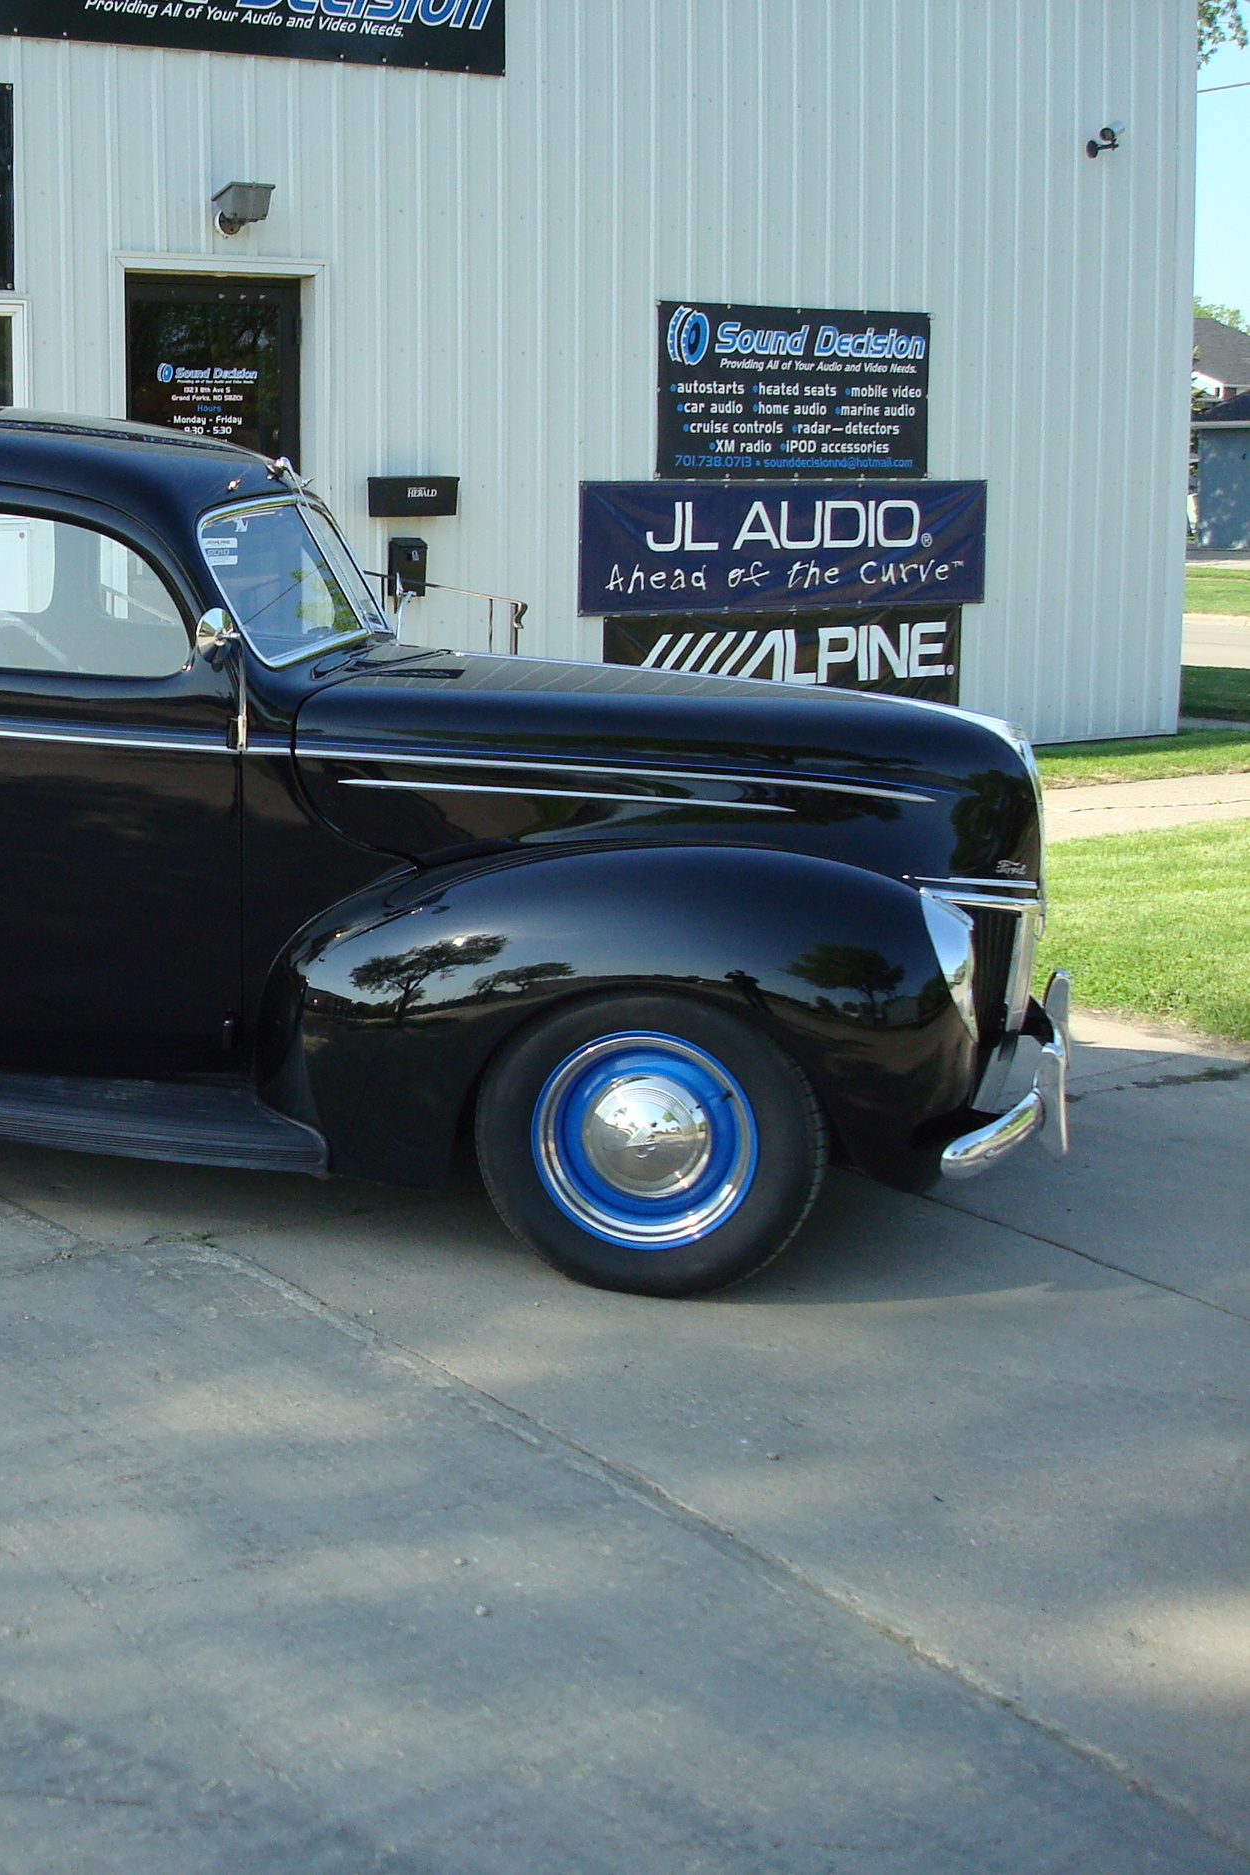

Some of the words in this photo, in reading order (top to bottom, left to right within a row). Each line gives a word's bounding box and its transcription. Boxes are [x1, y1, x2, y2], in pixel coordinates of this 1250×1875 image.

[85, 0, 158, 17] Providing
[160, 3, 183, 17] All
[185, 5, 204, 19] of
[205, 6, 238, 22] Your
[240, 12, 283, 27] Audio
[285, 15, 313, 28] and
[317, 18, 356, 33] Video
[359, 21, 404, 37] Needs.
[715, 322, 809, 357] Sound
[814, 326, 925, 359] Decision
[720, 358, 764, 371] Providing
[766, 360, 779, 370] All
[781, 360, 792, 371] of
[794, 361, 815, 371] Your
[816, 362, 842, 373] Audio
[845, 363, 861, 373] and
[863, 363, 888, 374] Video
[890, 364, 917, 374] Needs.
[175, 367, 211, 379] Sound
[213, 368, 258, 380] Decision
[677, 381, 745, 395] autostarts
[758, 382, 799, 396] heated
[804, 384, 837, 397] seats
[851, 384, 888, 398] mobile
[892, 385, 922, 398] video
[197, 404, 222, 412] Hours
[684, 403, 705, 414] car
[710, 401, 743, 414] audio
[758, 403, 789, 415] home
[794, 402, 827, 415] audio
[840, 404, 880, 416] marine
[884, 403, 916, 417] audio
[173, 415, 206, 425] Monday
[215, 415, 243, 425] Friday
[689, 421, 728, 434] cruise
[733, 421, 783, 434] controls
[715, 440, 735, 452] XM
[740, 440, 772, 453] radio
[786, 440, 816, 453] iPOD
[821, 440, 890, 453] accessories
[675, 455, 752, 468] 701.738.0713
[407, 489, 437, 497] HERALD
[645, 501, 719, 552] JL
[605, 563, 706, 595] Ahead
[727, 561, 770, 589] of
[787, 559, 840, 589] the
